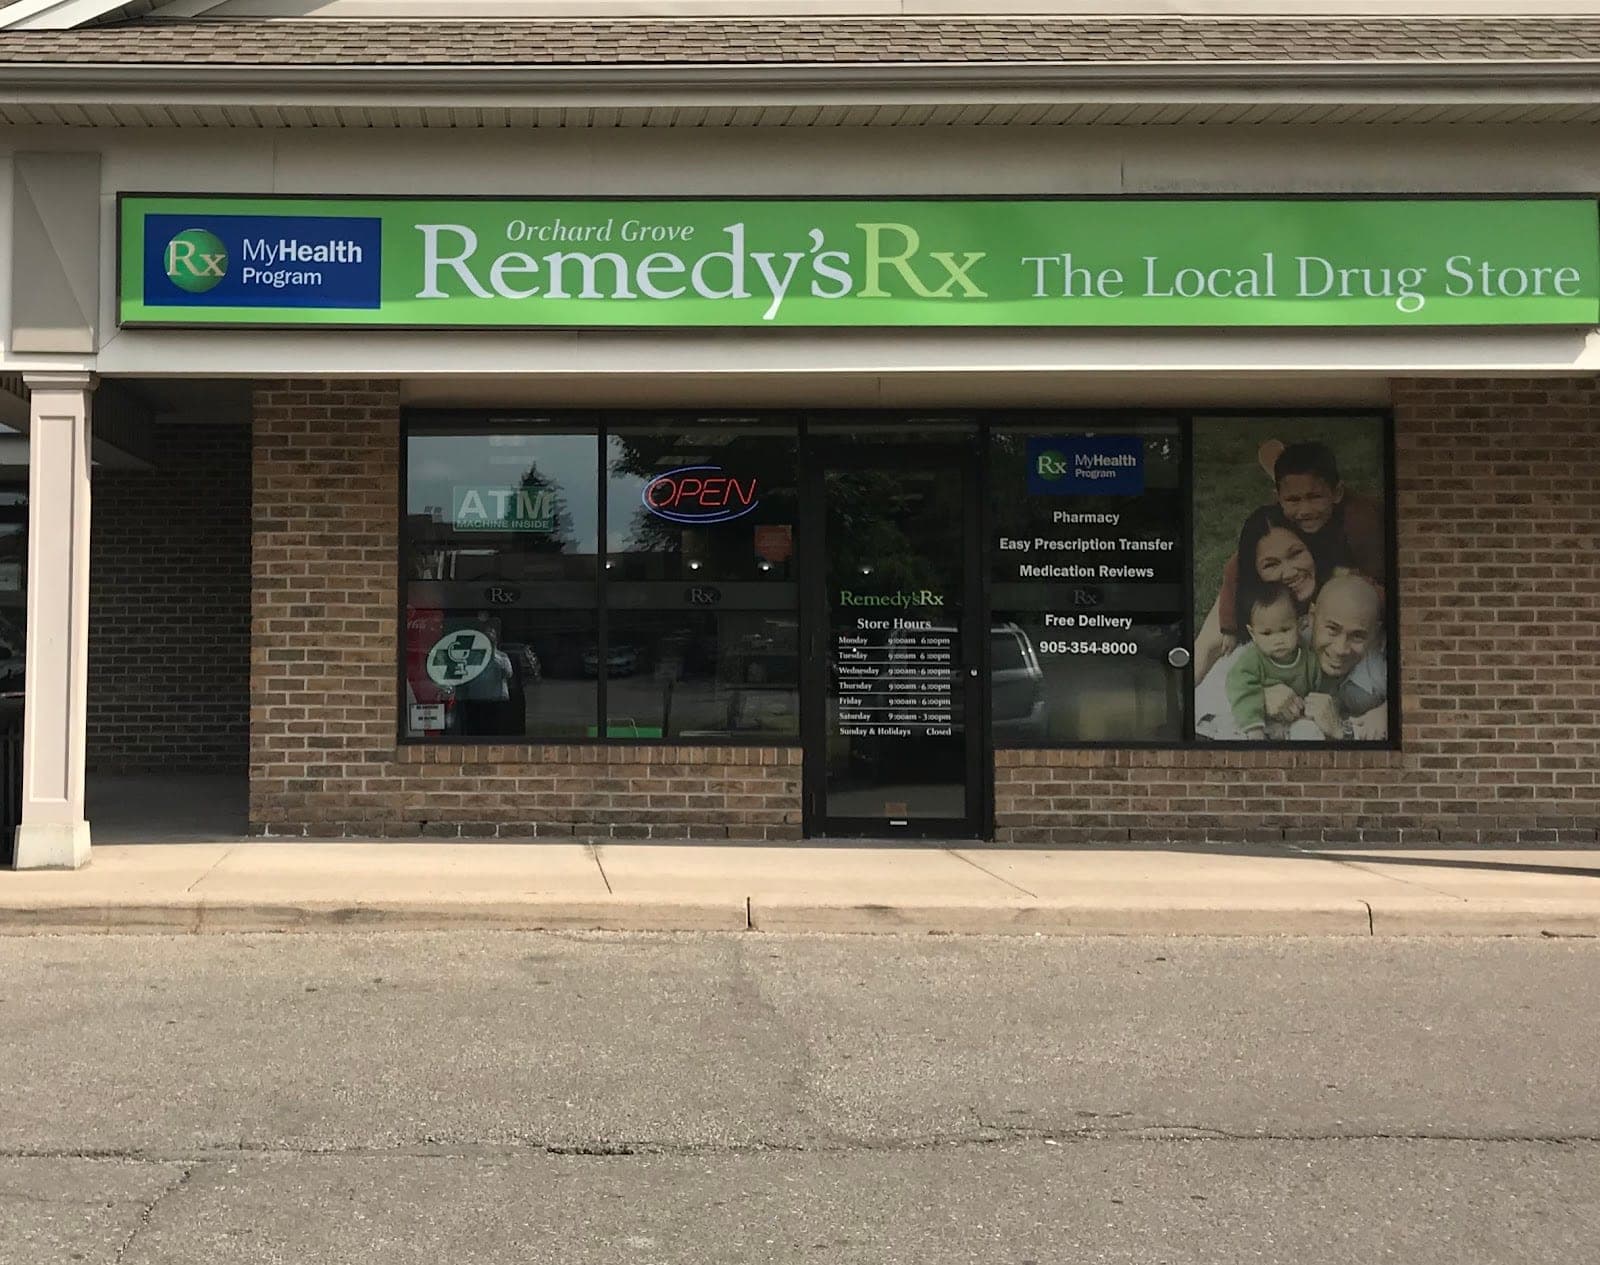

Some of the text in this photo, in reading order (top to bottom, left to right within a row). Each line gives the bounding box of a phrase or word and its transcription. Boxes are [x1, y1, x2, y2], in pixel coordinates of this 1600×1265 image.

[506, 219, 695, 241] Orchard Grove
[166, 239, 228, 277] Rx
[242, 238, 362, 268] MyHealth
[242, 267, 322, 290] Program
[1021, 253, 1580, 313] The Local Drug Store
[1037, 455, 1067, 475] Rx
[1075, 454, 1137, 469] MyHealth
[1075, 468, 1116, 479] Program
[648, 478, 757, 507] OPEN
[458, 490, 551, 520] ATM
[457, 520, 550, 529] MACHINE INSIDE
[1053, 511, 1120, 526] Pharmacy
[999, 538, 1174, 552] Easy Prescription Transfer
[1019, 565, 1154, 578] Medication Reviews
[490, 587, 514, 603] Rx
[691, 587, 715, 603] Rx
[1074, 589, 1097, 605] Rx
[857, 618, 932, 630] Store Hours
[1045, 614, 1133, 630] Free Delivery
[838, 636, 868, 645] Monday
[1039, 641, 1138, 655] 905-354-8000
[838, 651, 868, 661] Tuesday
[838, 667, 880, 676] Wednesday
[838, 682, 872, 691] Thursday
[839, 697, 862, 707] Friday
[839, 712, 871, 722] Saturday
[840, 727, 951, 737] Sunday & Holidays Closed
